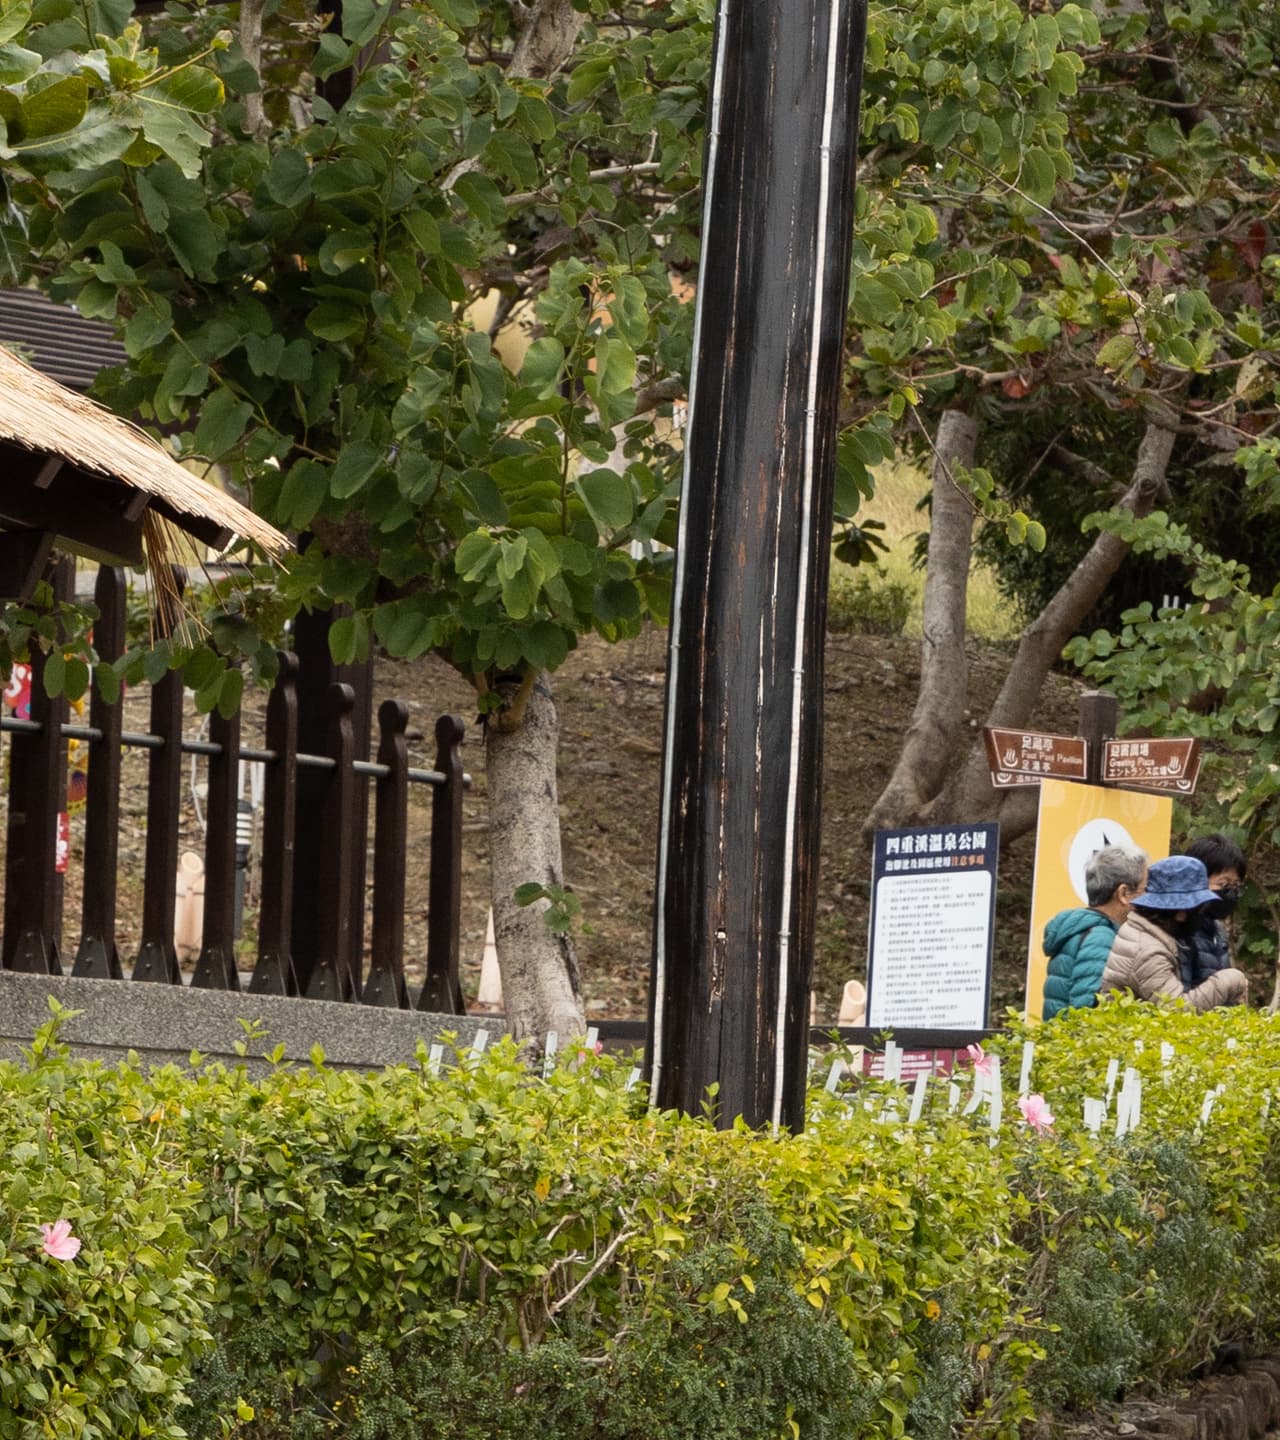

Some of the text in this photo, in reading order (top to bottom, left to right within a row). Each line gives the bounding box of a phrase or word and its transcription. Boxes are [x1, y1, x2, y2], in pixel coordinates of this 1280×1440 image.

[886, 831, 987, 855] 四重溪溫泉公園
